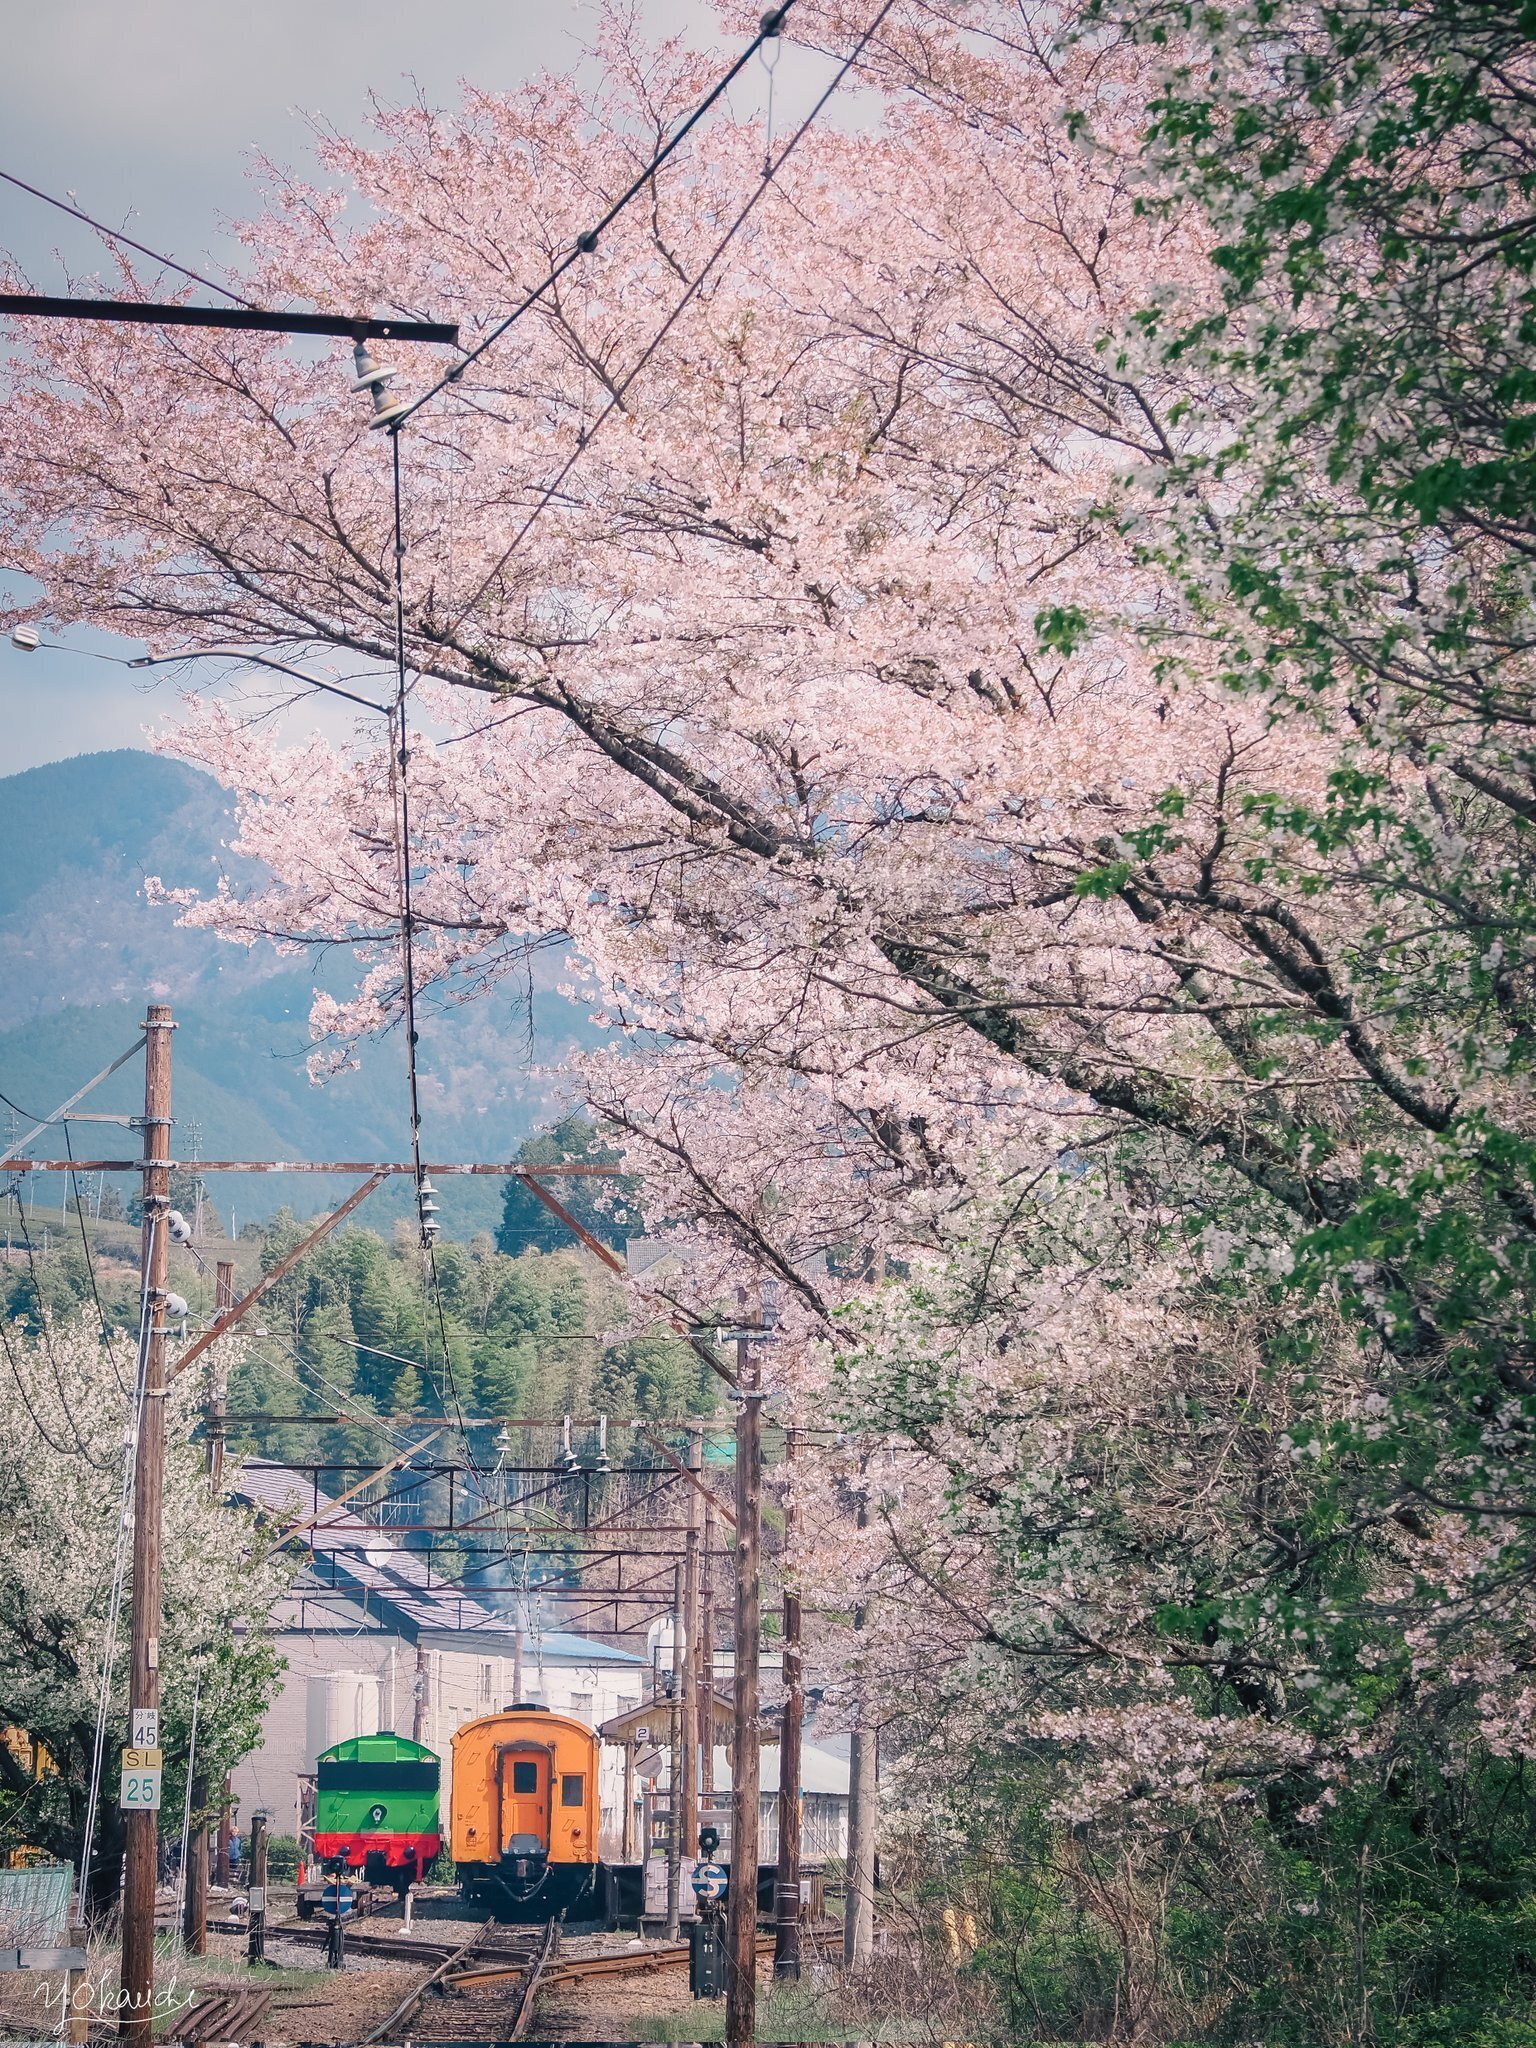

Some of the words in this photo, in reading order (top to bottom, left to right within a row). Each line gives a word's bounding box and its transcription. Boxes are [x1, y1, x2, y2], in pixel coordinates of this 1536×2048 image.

[135, 1711, 156, 1720] 分岐
[135, 1726, 156, 1745] 45
[638, 1728, 647, 1738] 2
[127, 1778, 154, 1802] 25
